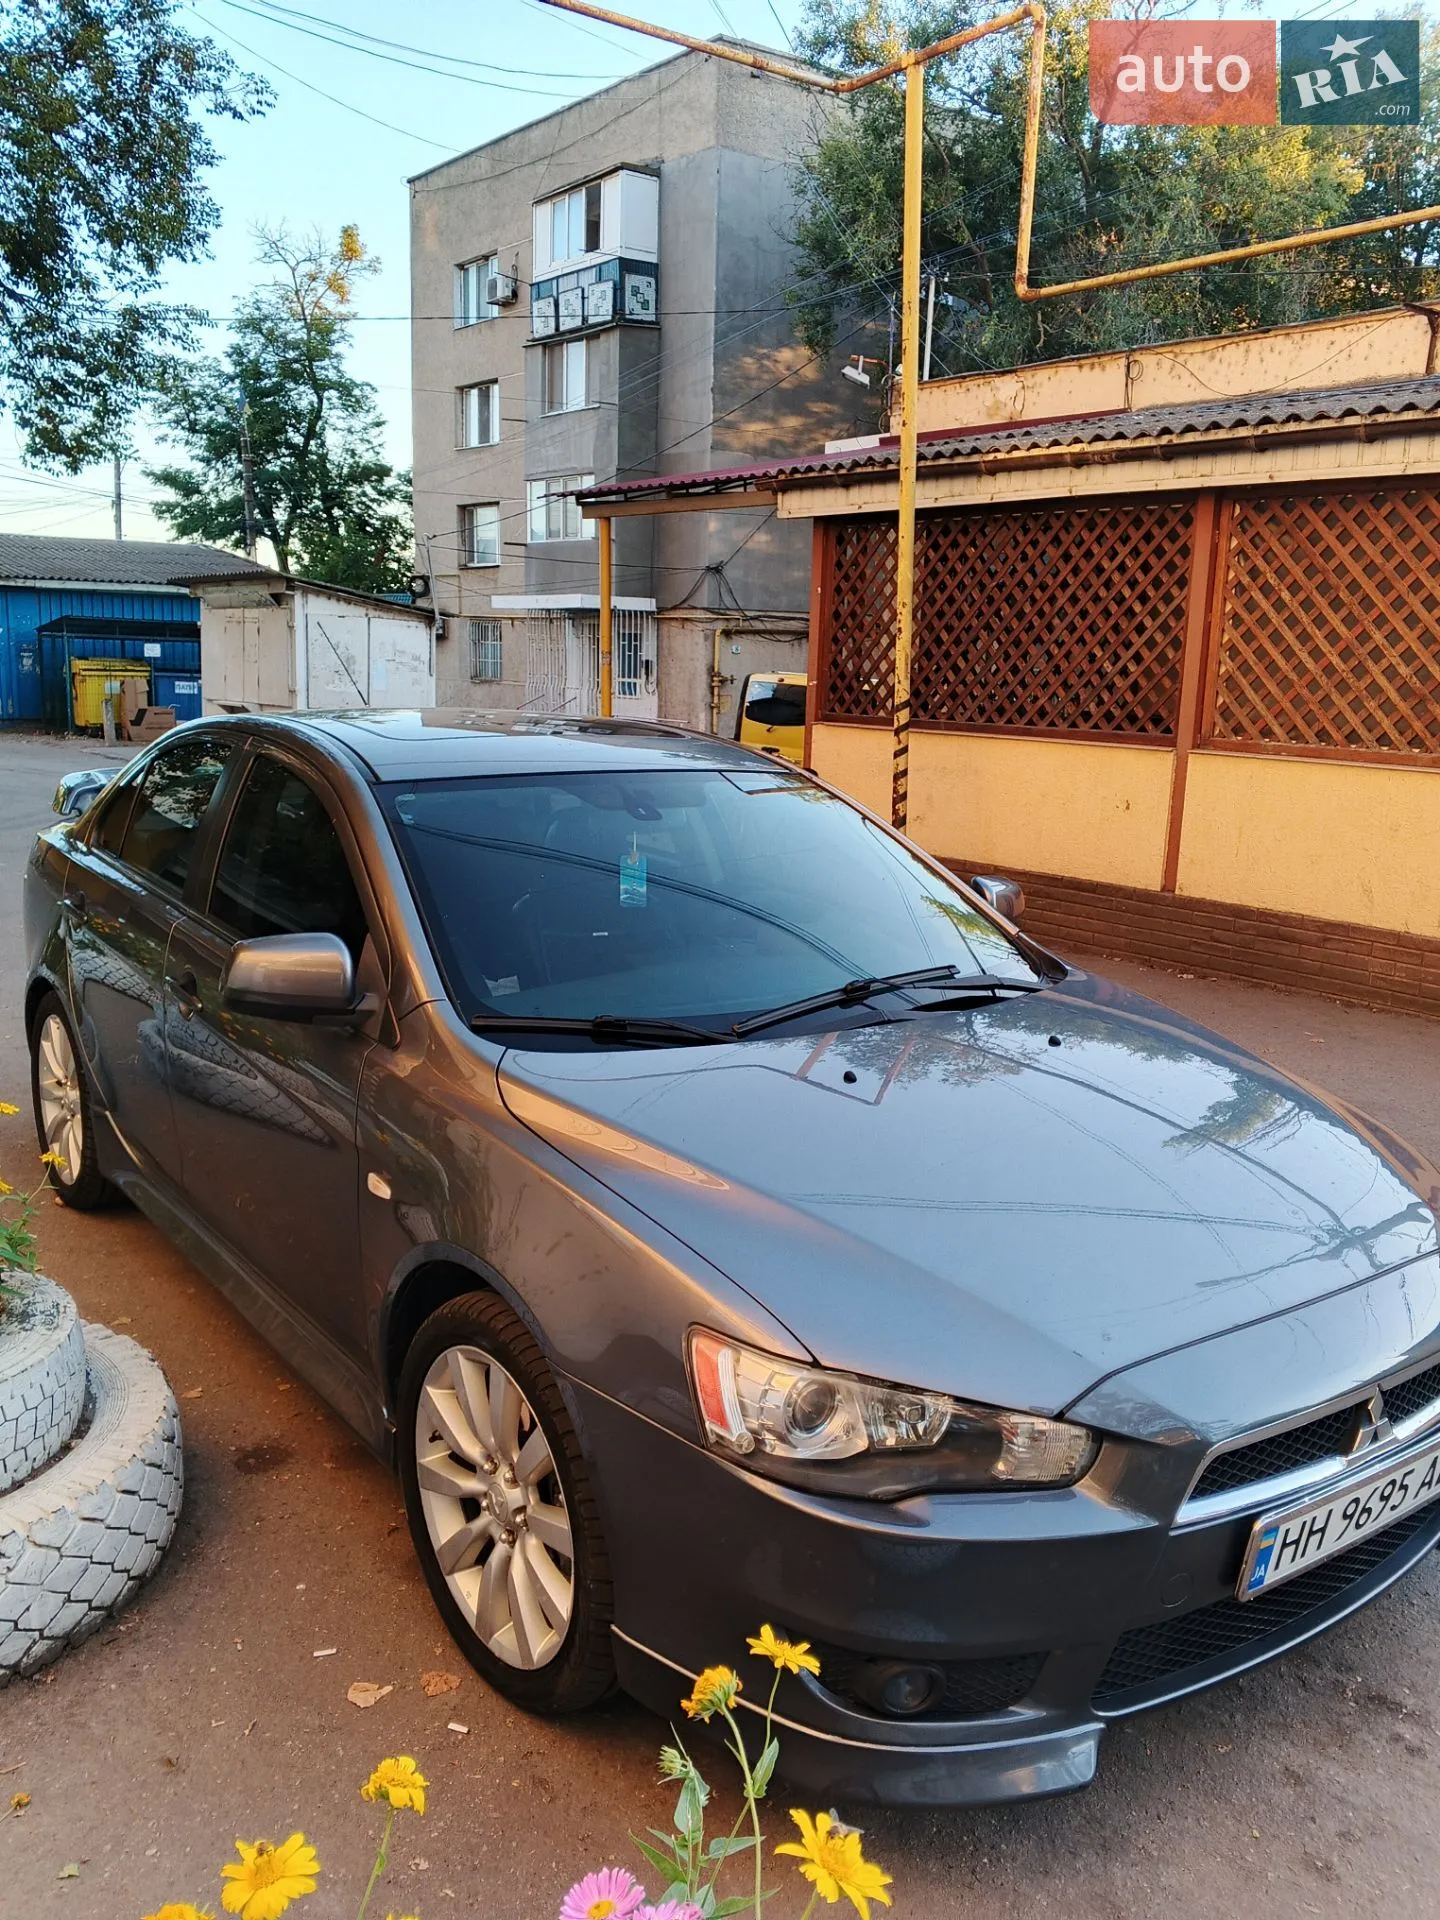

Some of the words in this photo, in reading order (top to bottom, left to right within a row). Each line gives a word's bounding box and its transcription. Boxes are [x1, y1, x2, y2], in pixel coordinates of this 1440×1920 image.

[1273, 1508, 1334, 1572] HH
[1334, 1468, 1415, 1542] 9695
[1413, 1455, 1440, 1500] A
